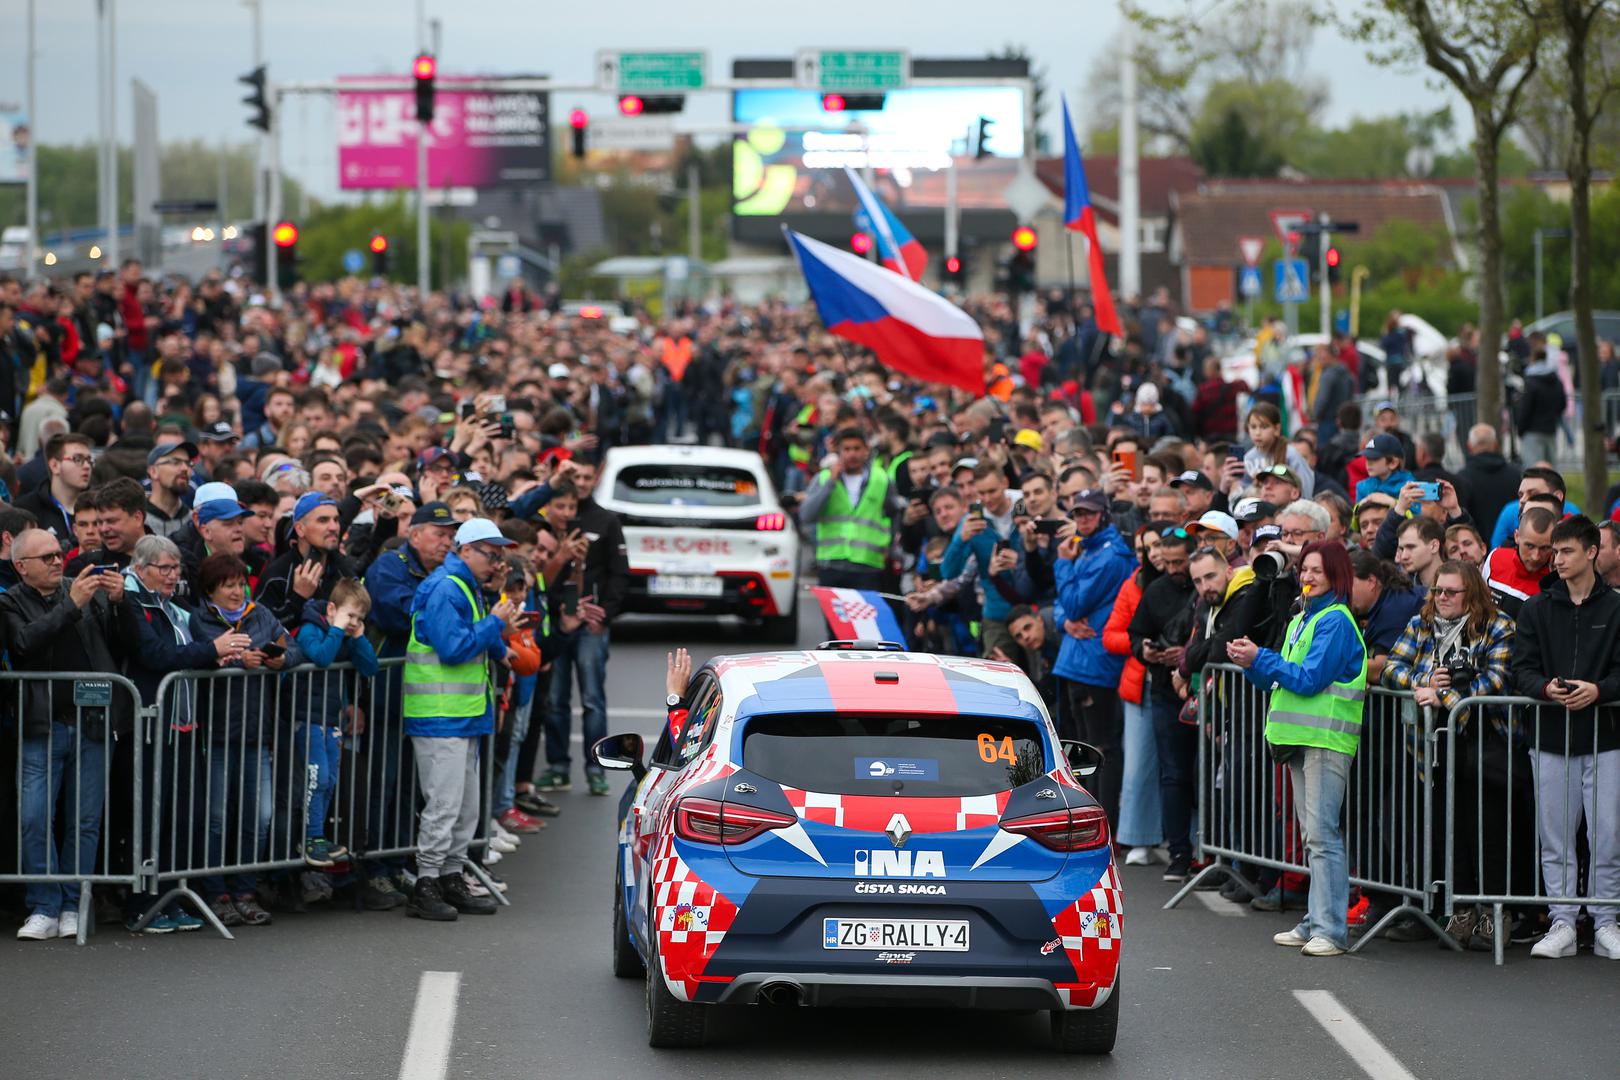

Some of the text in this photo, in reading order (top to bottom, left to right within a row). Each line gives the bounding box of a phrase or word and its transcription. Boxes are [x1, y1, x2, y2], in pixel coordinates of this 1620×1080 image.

[977, 733, 1017, 766] 64
[855, 882, 947, 895] ČISTA SNAGA
[840, 923, 867, 946] ZG
